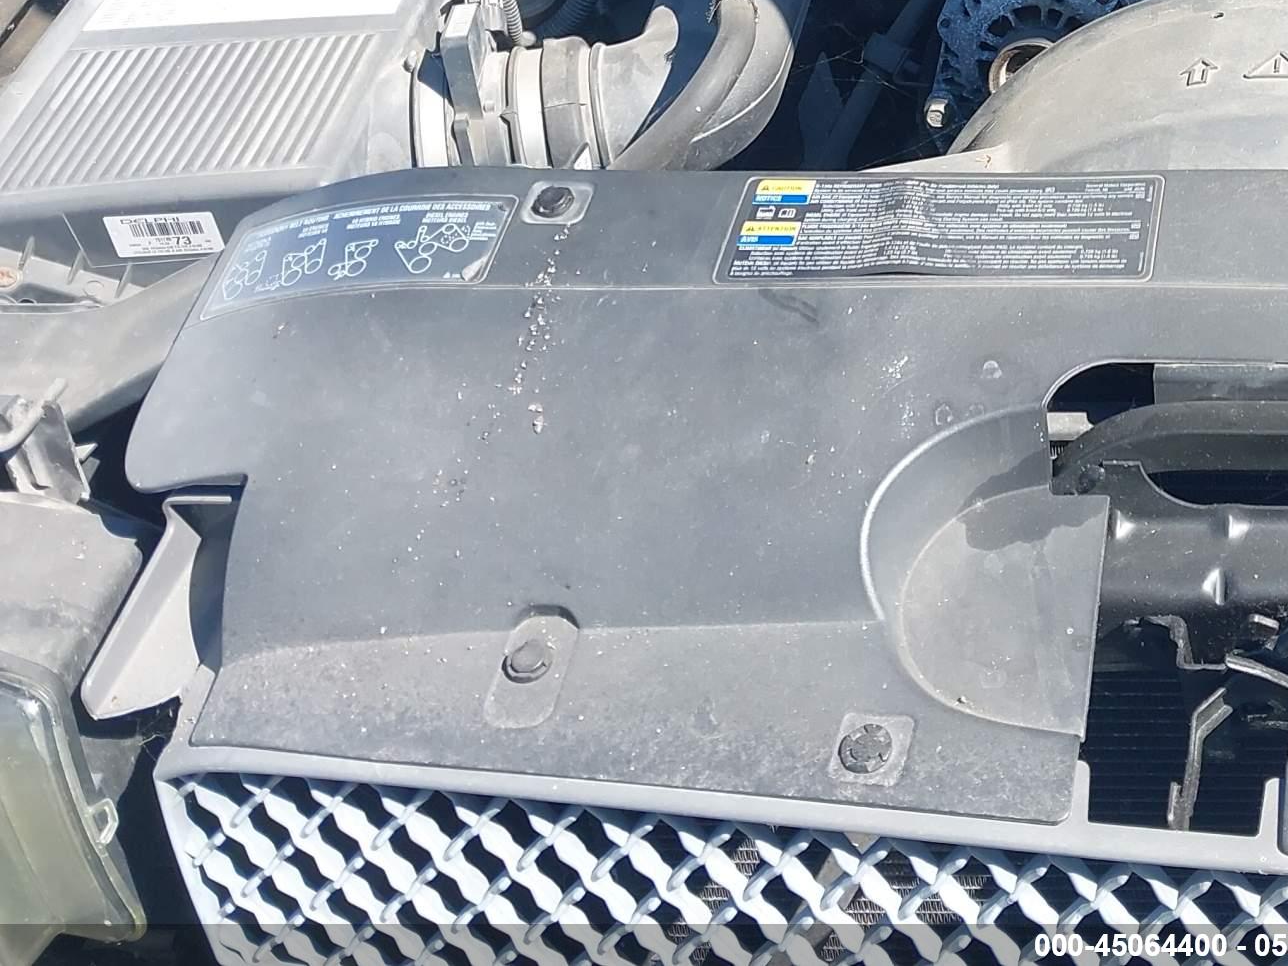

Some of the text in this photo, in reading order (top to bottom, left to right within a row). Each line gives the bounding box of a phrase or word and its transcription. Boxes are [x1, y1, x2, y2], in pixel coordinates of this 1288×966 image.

[755, 194, 783, 203] NOTICE
[120, 217, 179, 225] DELPHI
[172, 236, 192, 246] 73
